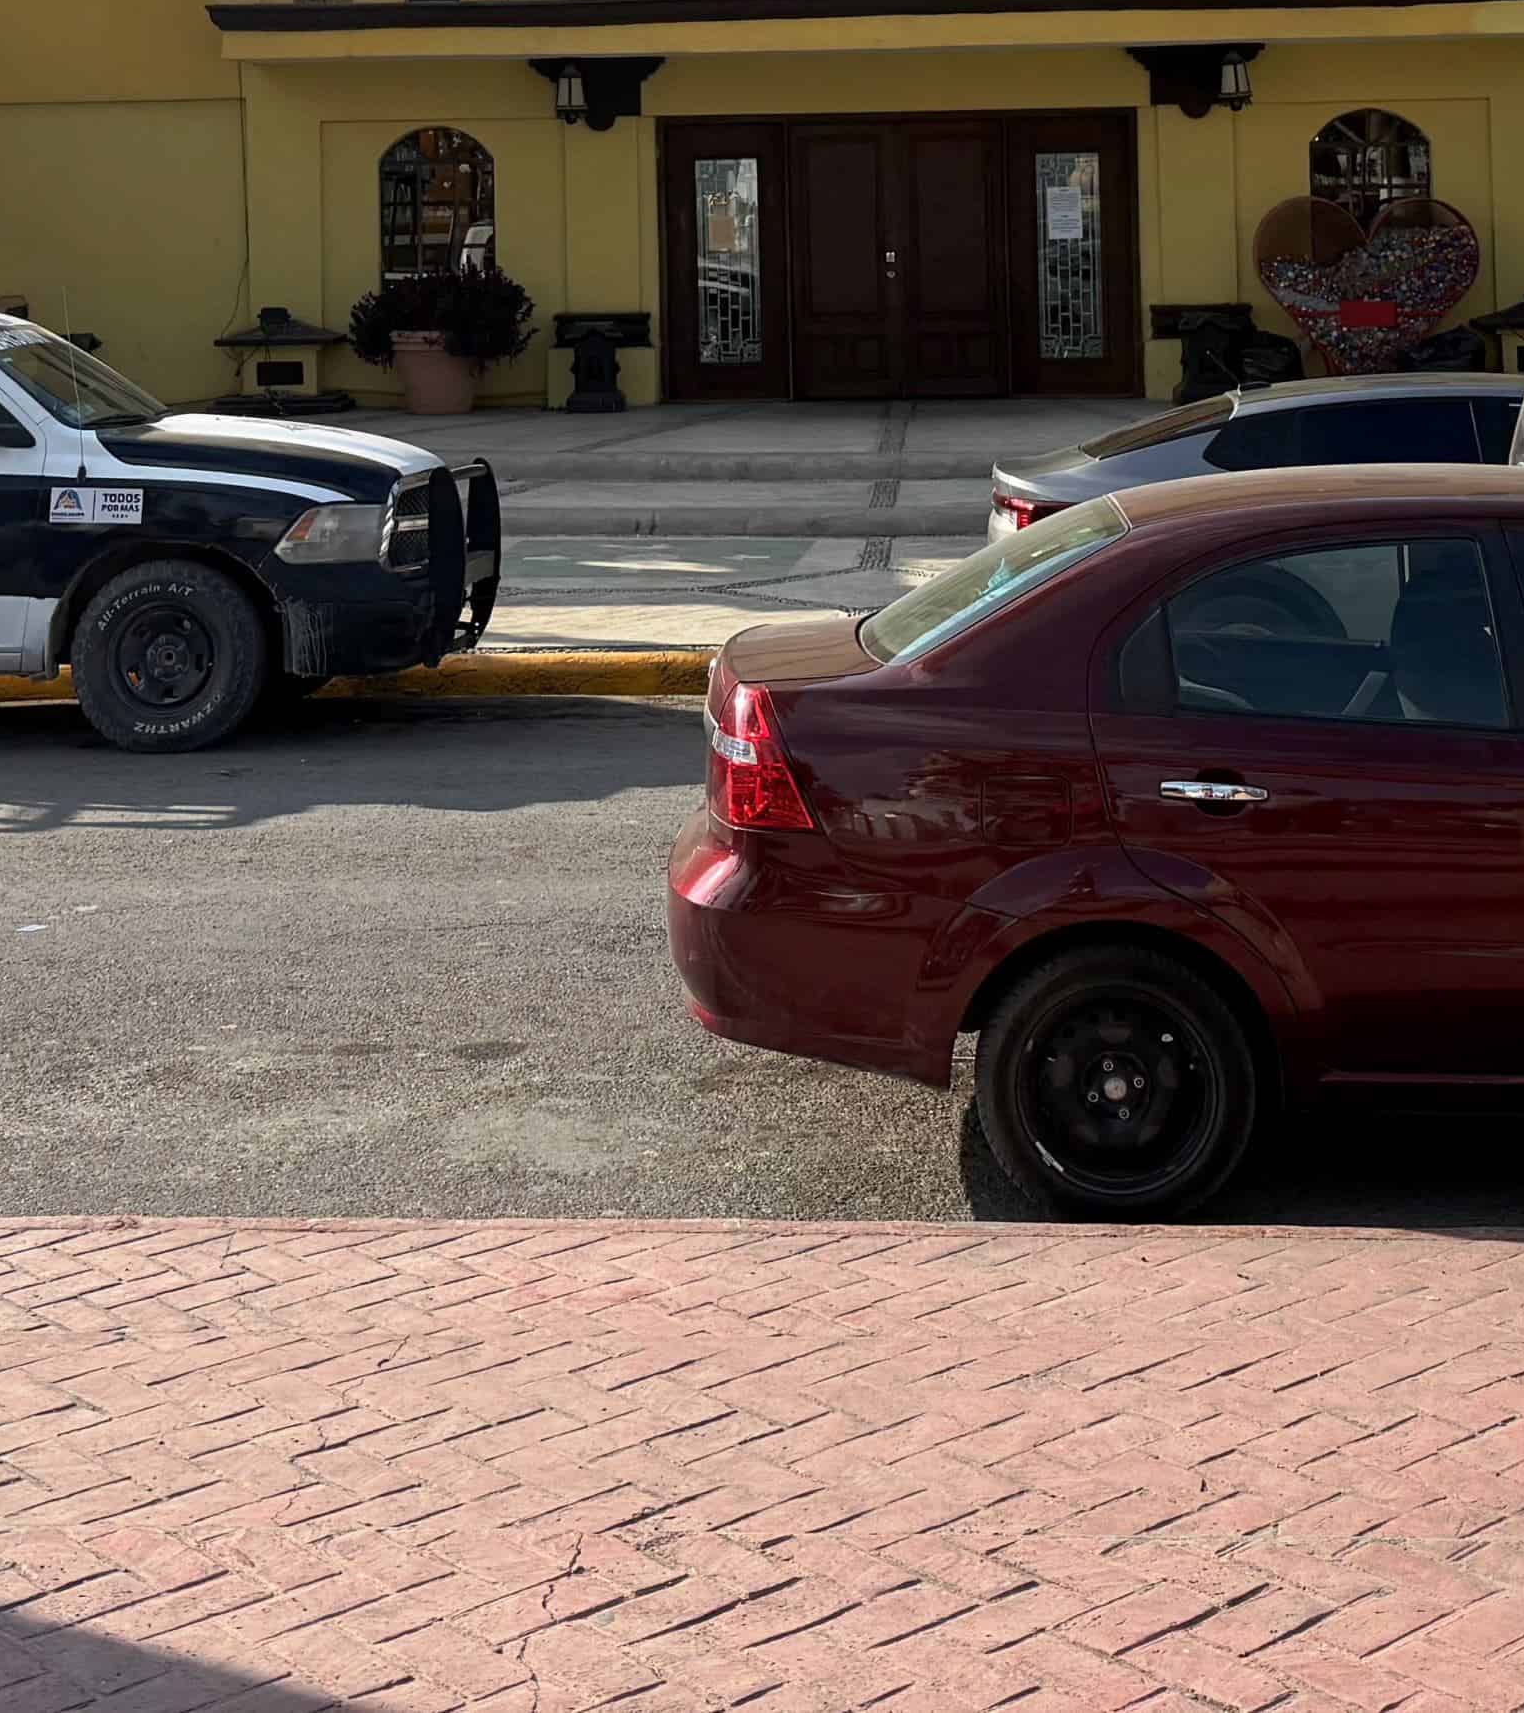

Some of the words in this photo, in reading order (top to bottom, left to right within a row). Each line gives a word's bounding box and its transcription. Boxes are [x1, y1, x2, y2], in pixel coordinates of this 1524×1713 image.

[102, 493, 141, 503] TODOS
[101, 504, 119, 512] POR
[97, 583, 161, 631] All-Terrain
[167, 583, 195, 597] A/T
